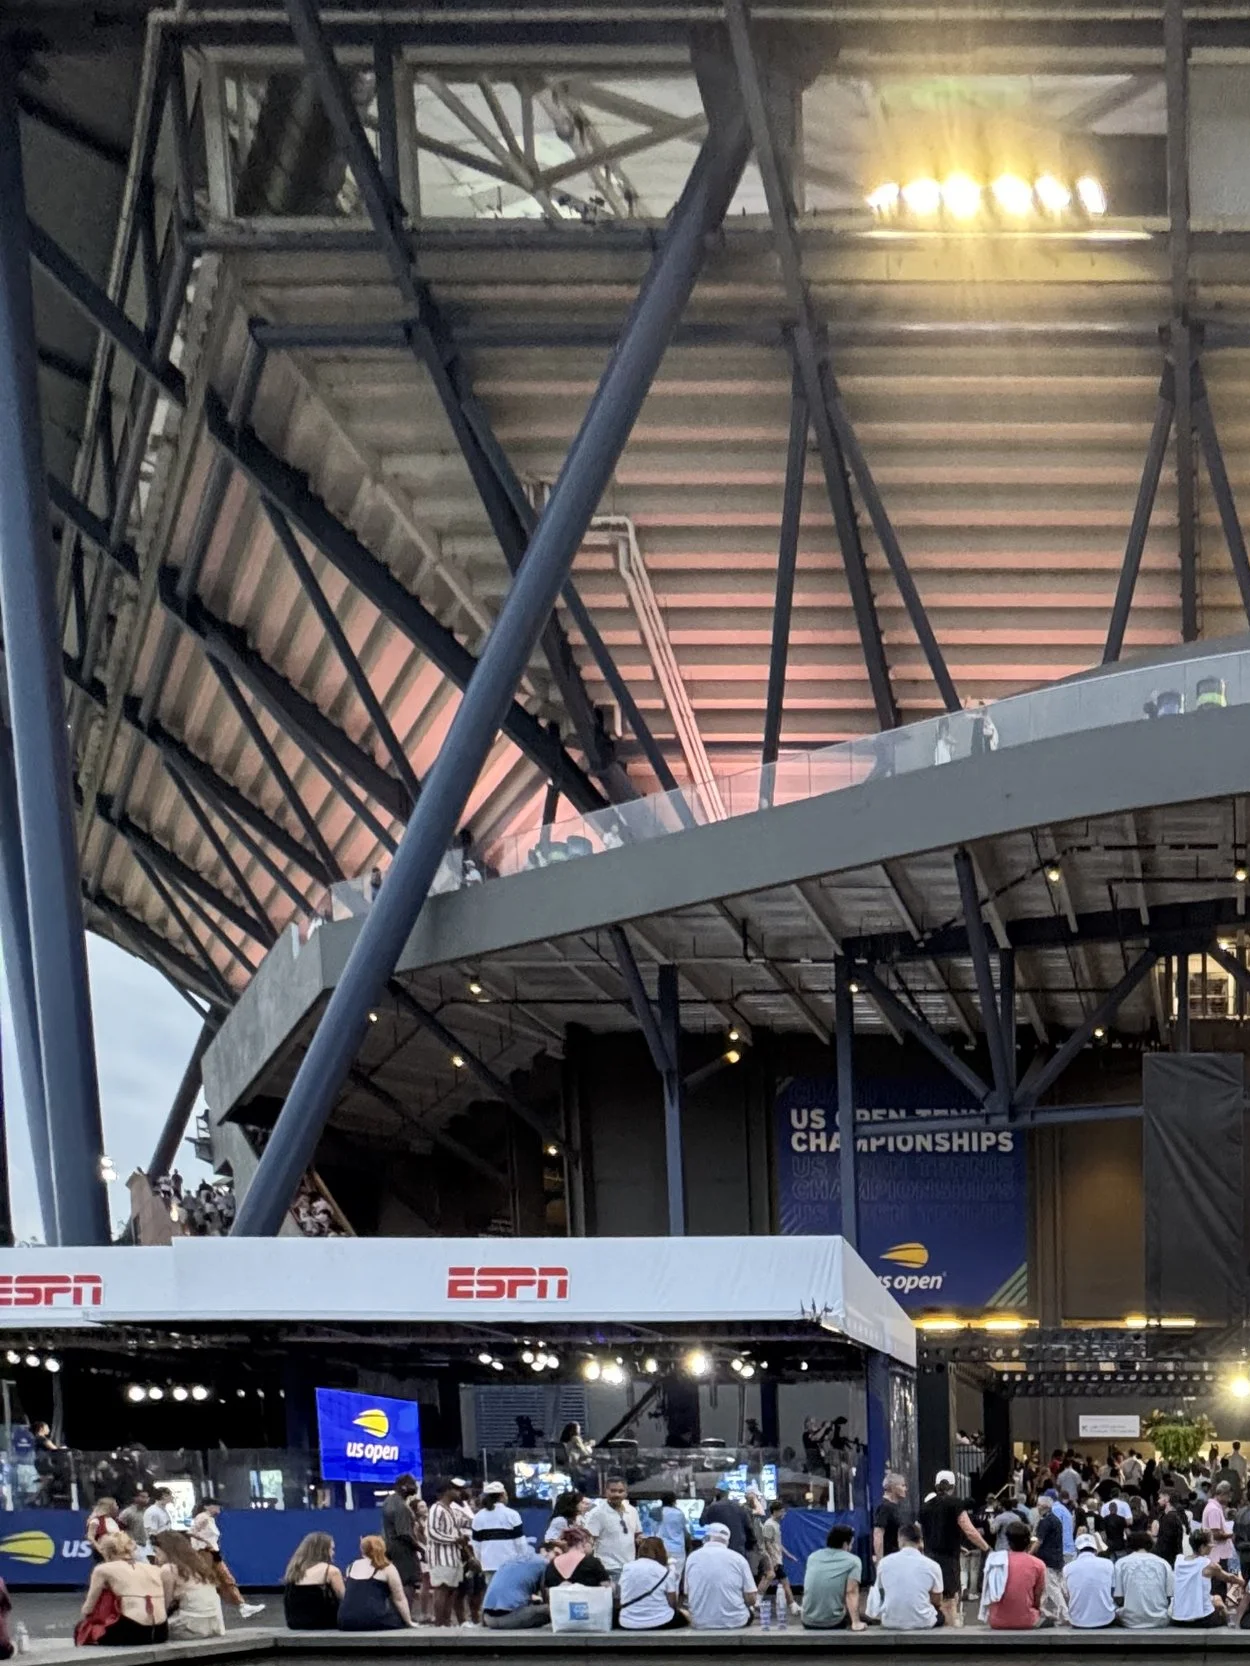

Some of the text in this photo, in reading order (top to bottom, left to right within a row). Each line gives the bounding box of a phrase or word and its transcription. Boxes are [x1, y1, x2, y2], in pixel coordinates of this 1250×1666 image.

[790, 1107, 827, 1130] US
[447, 1267, 568, 1298] ESPN
[894, 1275, 943, 1294] open
[346, 1442, 399, 1465] us open
[62, 1539, 93, 1558] us
